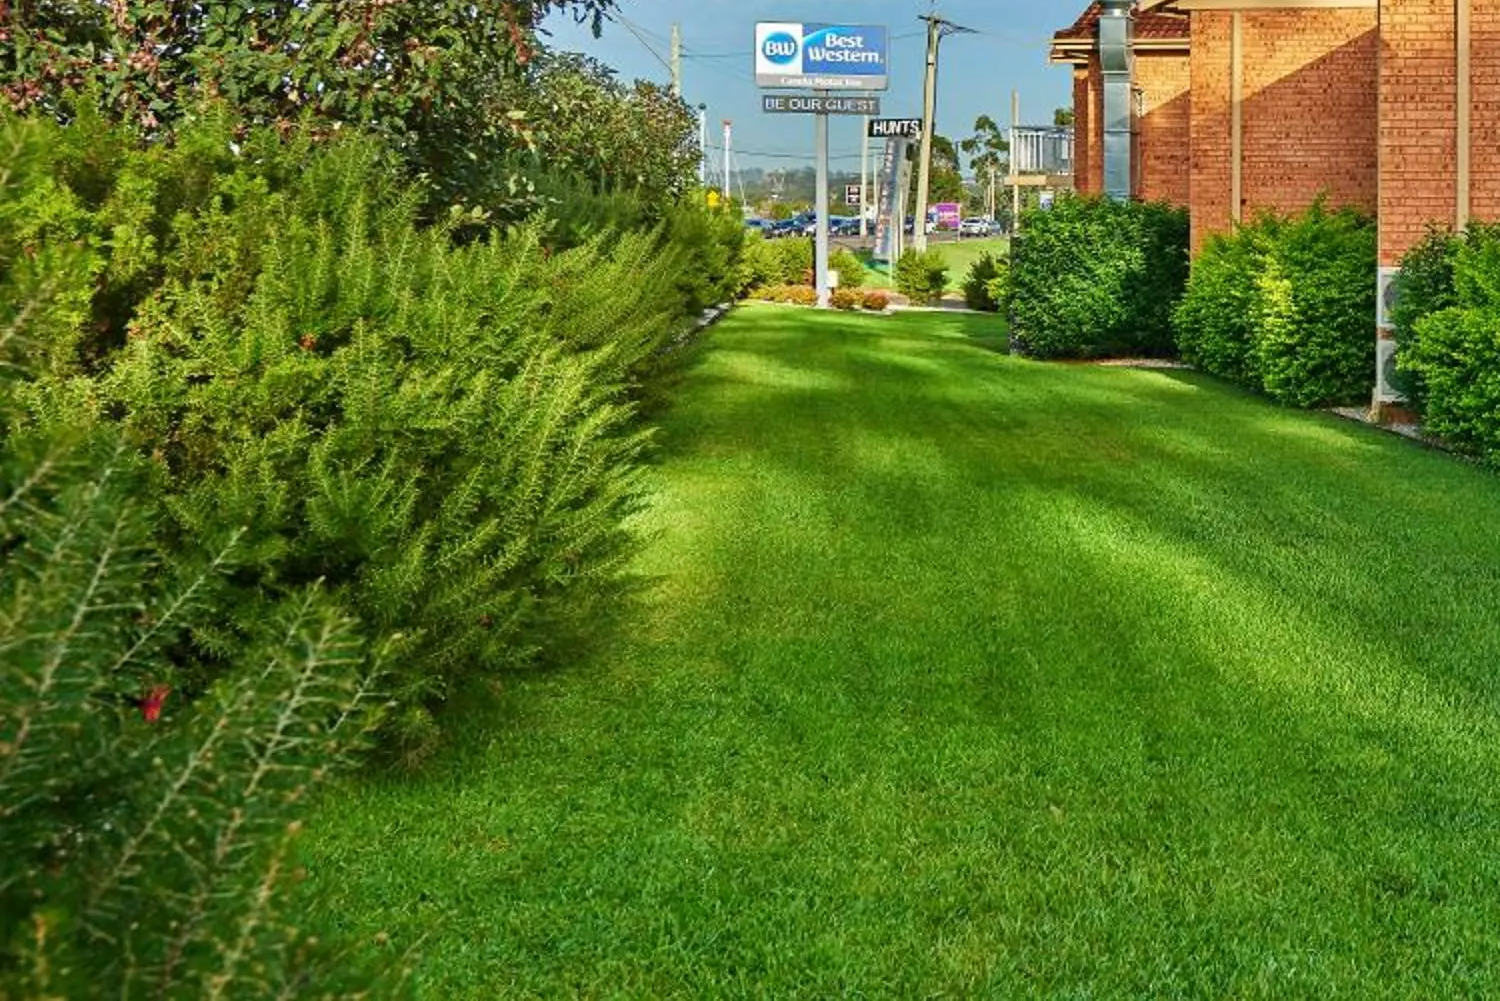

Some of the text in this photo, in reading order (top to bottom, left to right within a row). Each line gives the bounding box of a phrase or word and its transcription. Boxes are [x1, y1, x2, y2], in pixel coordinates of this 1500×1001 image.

[825, 32, 864, 47] Best
[765, 41, 795, 55] BW
[808, 47, 880, 62] Western
[765, 98, 876, 112] BE OUR GUEST
[873, 120, 919, 135] HUNTS
